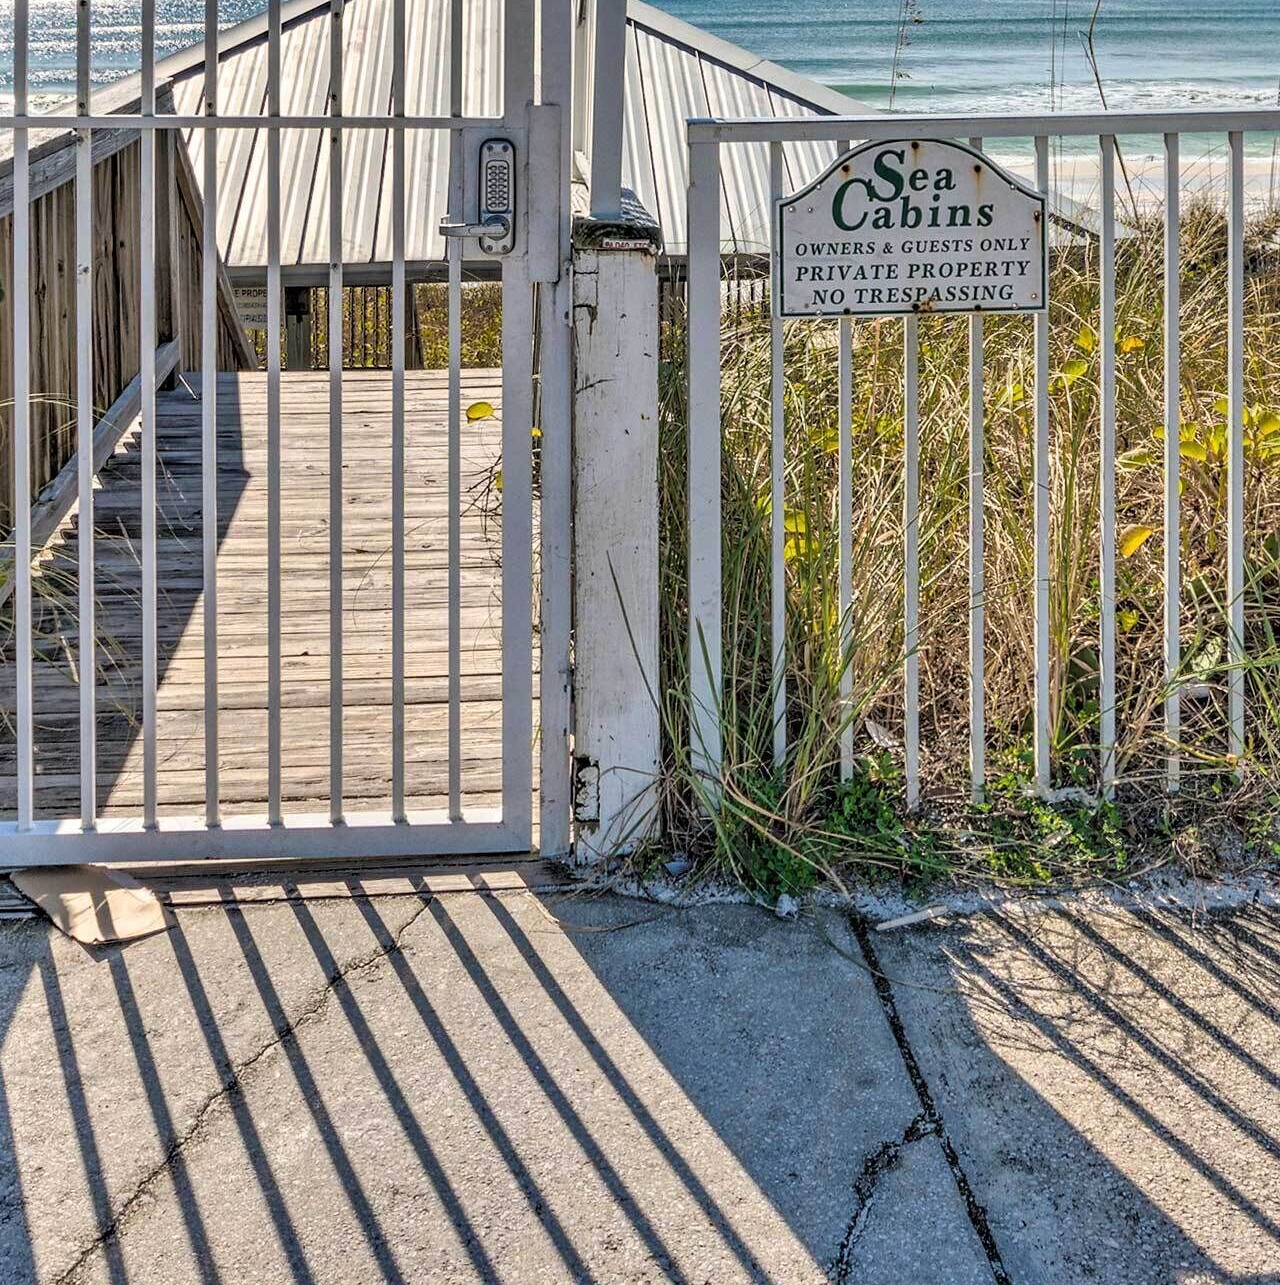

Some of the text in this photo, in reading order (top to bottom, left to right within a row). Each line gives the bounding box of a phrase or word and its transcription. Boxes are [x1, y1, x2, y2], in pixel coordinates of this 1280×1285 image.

[869, 149, 956, 202] Sea
[832, 177, 994, 231] Cabins
[795, 237, 1030, 256] OWNERS & GUESTS ONLY
[795, 260, 1031, 282] PRIVATE PROPERTY
[811, 284, 1014, 305] NO TRESPASSING
